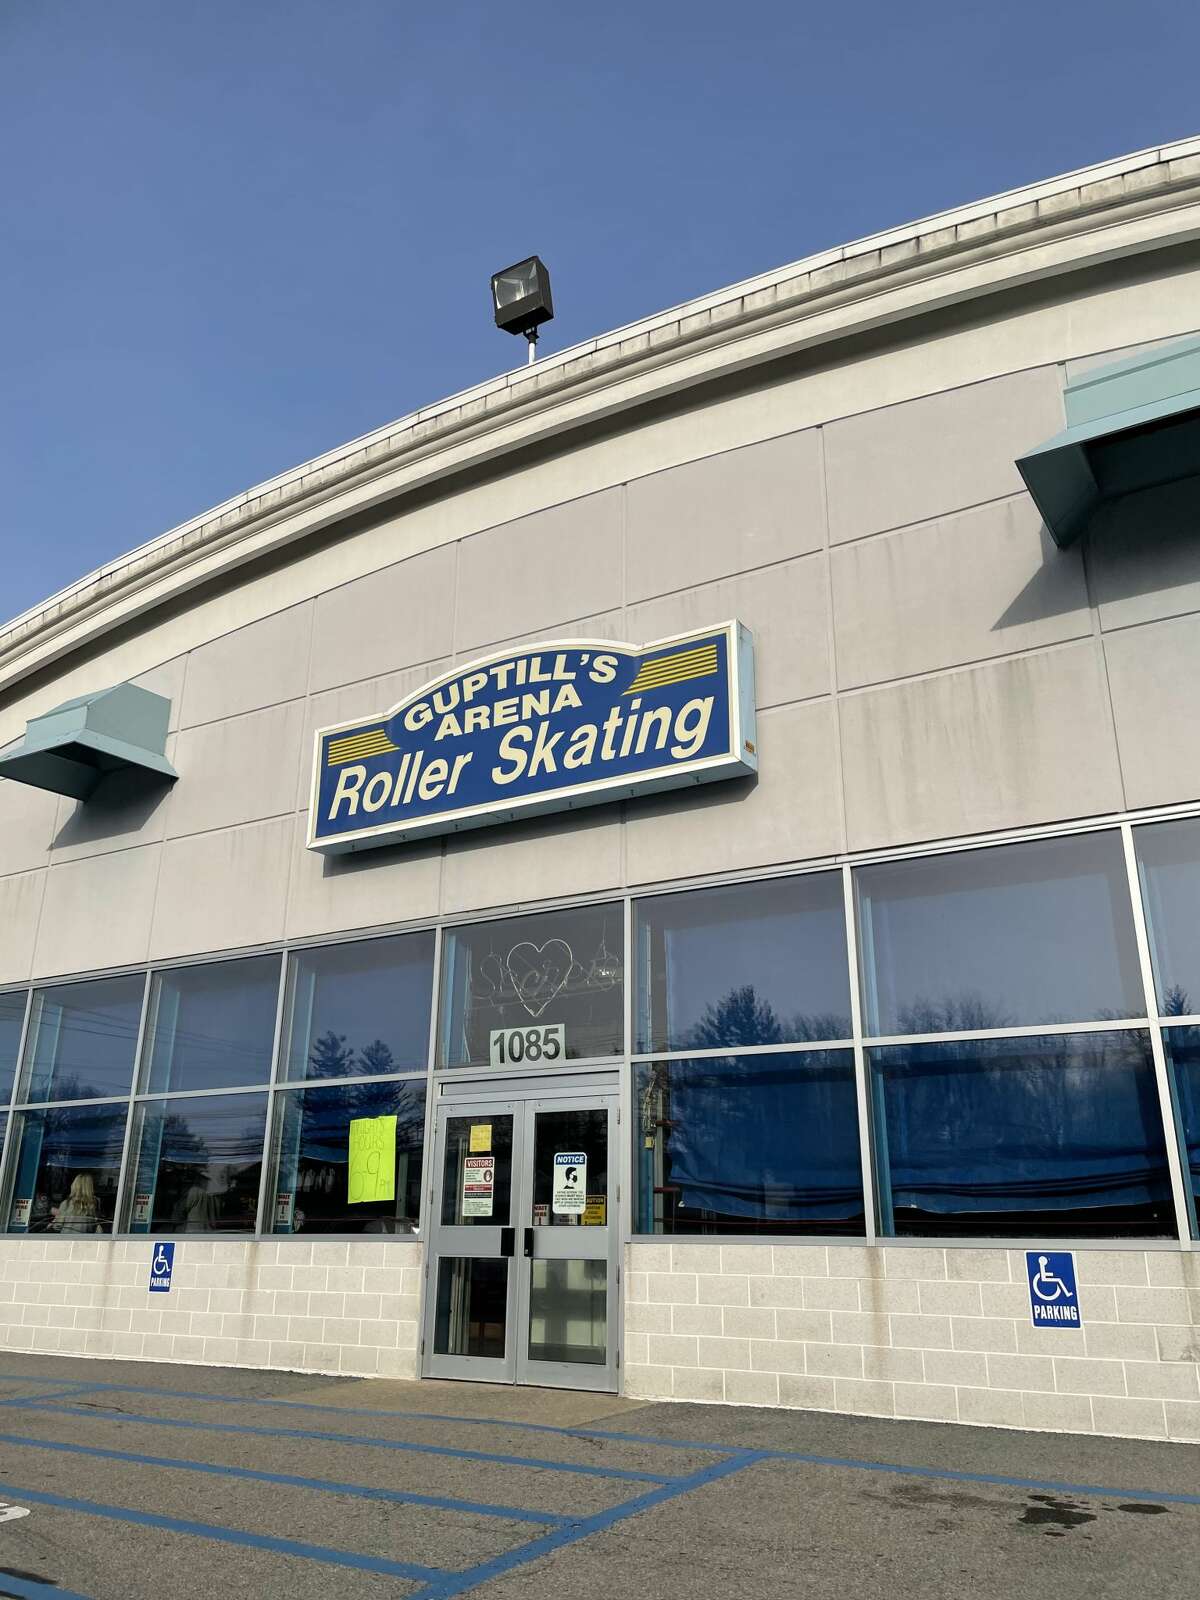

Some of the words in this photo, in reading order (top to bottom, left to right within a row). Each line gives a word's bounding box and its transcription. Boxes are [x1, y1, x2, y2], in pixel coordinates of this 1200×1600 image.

[404, 654, 619, 732] GUPTILL'S
[434, 684, 583, 742] ARENA
[328, 750, 473, 820] Roller
[491, 695, 715, 785] Skating
[493, 1027, 561, 1064] 1085
[467, 1159, 493, 1168] VISITORS
[556, 1155, 585, 1164] NOTICE
[150, 1277, 171, 1288] PARKING
[1034, 1305, 1078, 1321] PARKING
